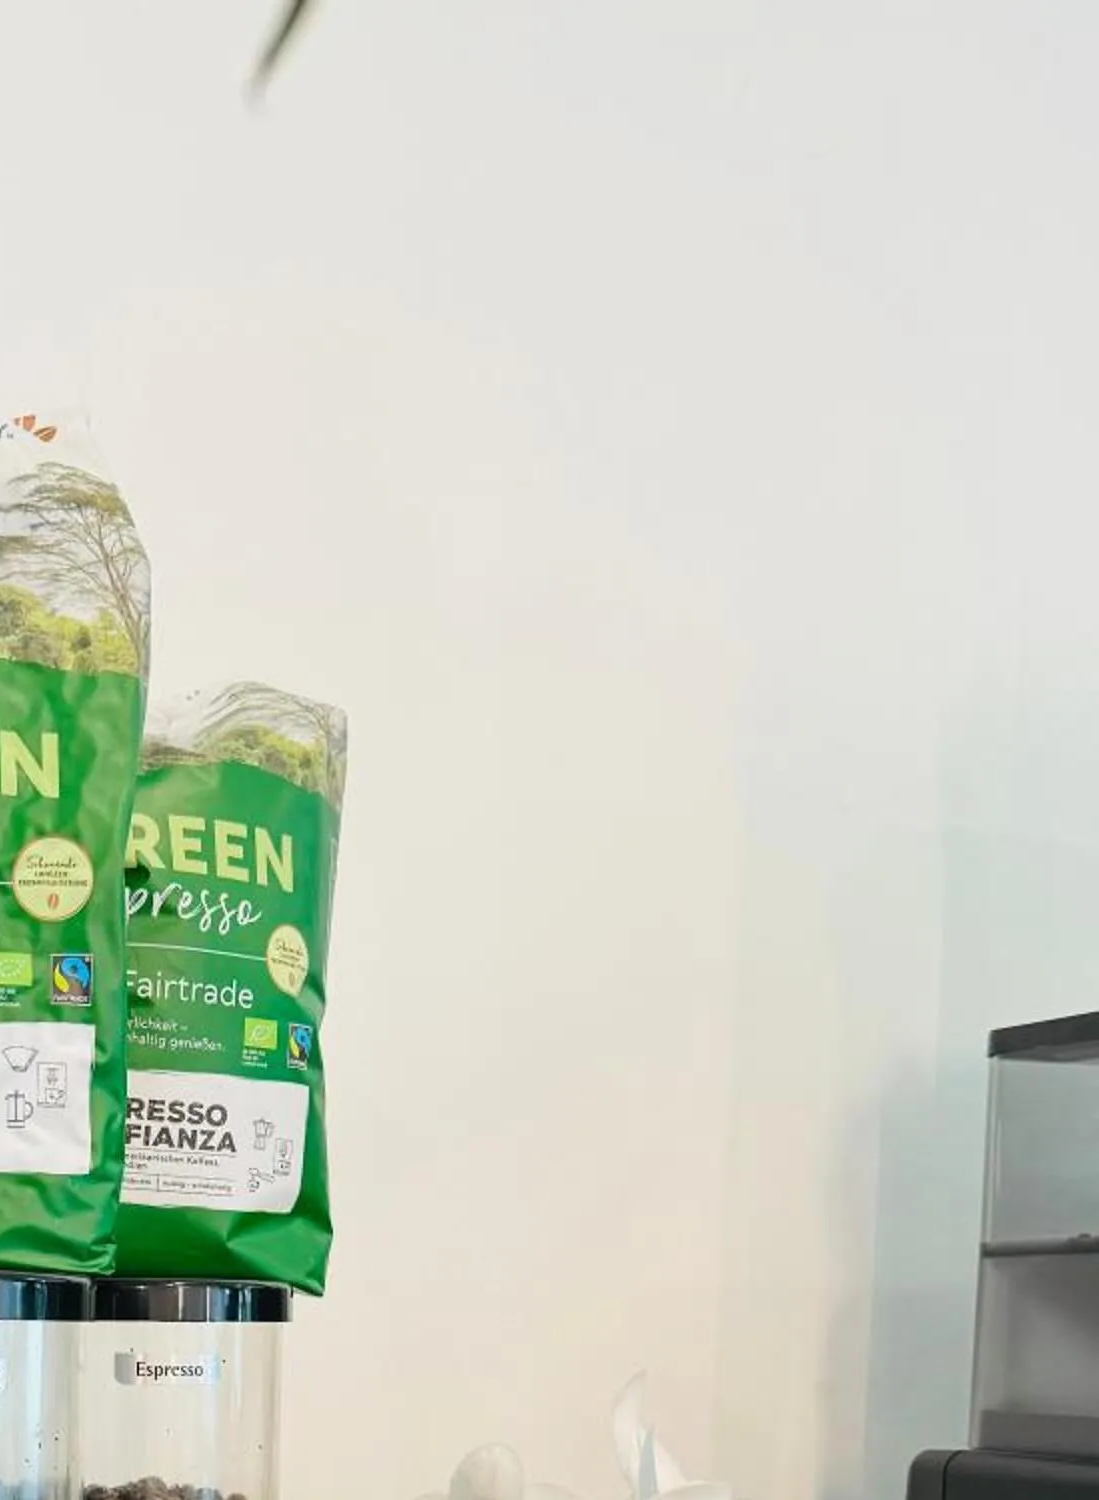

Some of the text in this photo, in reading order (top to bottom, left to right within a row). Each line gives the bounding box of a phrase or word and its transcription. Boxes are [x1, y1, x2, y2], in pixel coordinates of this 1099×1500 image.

[124, 813, 294, 893] REEN
[125, 882, 261, 935] presso
[126, 1096, 228, 1127] RESSO
[126, 1123, 237, 1153] FIANZA
[136, 1361, 204, 1382] Espresso
